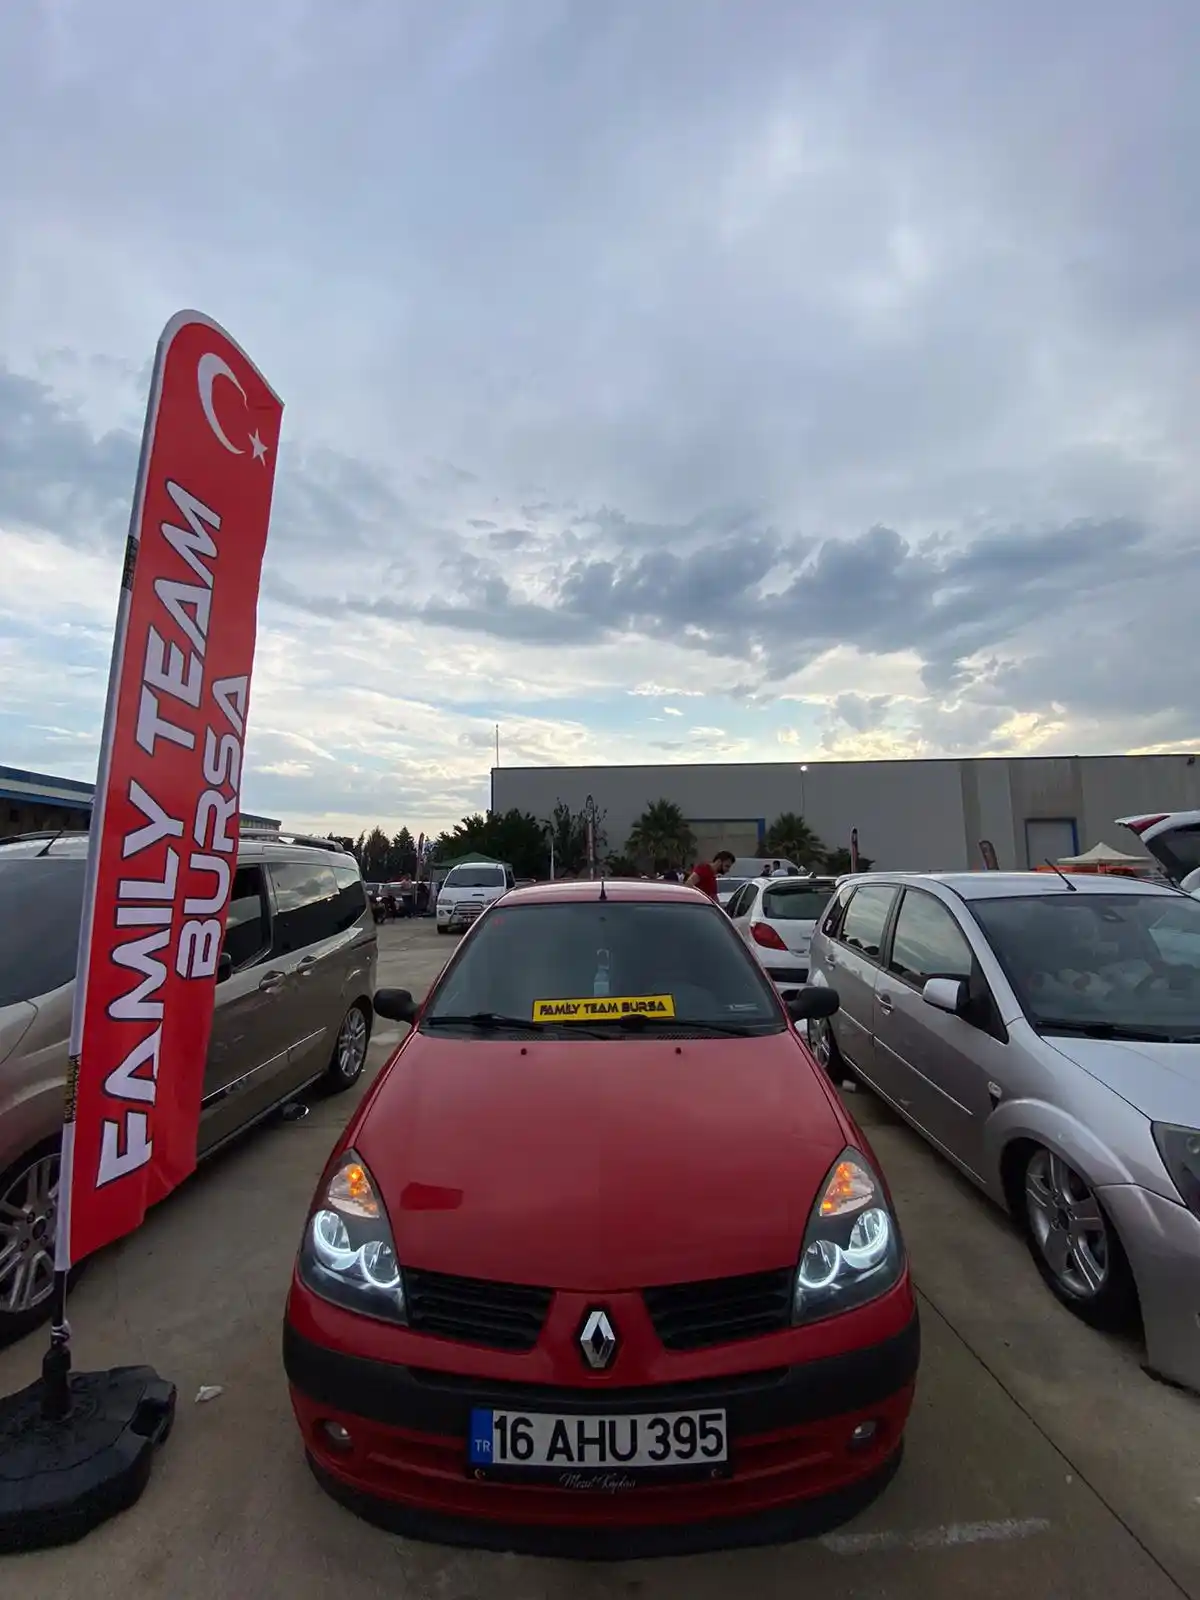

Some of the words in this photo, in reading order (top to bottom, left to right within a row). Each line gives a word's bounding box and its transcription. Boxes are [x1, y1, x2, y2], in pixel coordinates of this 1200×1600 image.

[136, 479, 222, 756] TEAM
[175, 675, 248, 980] BURSA
[96, 777, 184, 1189] FAMILY
[583, 1002, 619, 1014] TEAM
[621, 1001, 667, 1013] BURSA
[475, 1440, 491, 1452] TR
[494, 1415, 534, 1460] 16
[546, 1419, 637, 1462] AHU
[647, 1413, 723, 1460] 395
